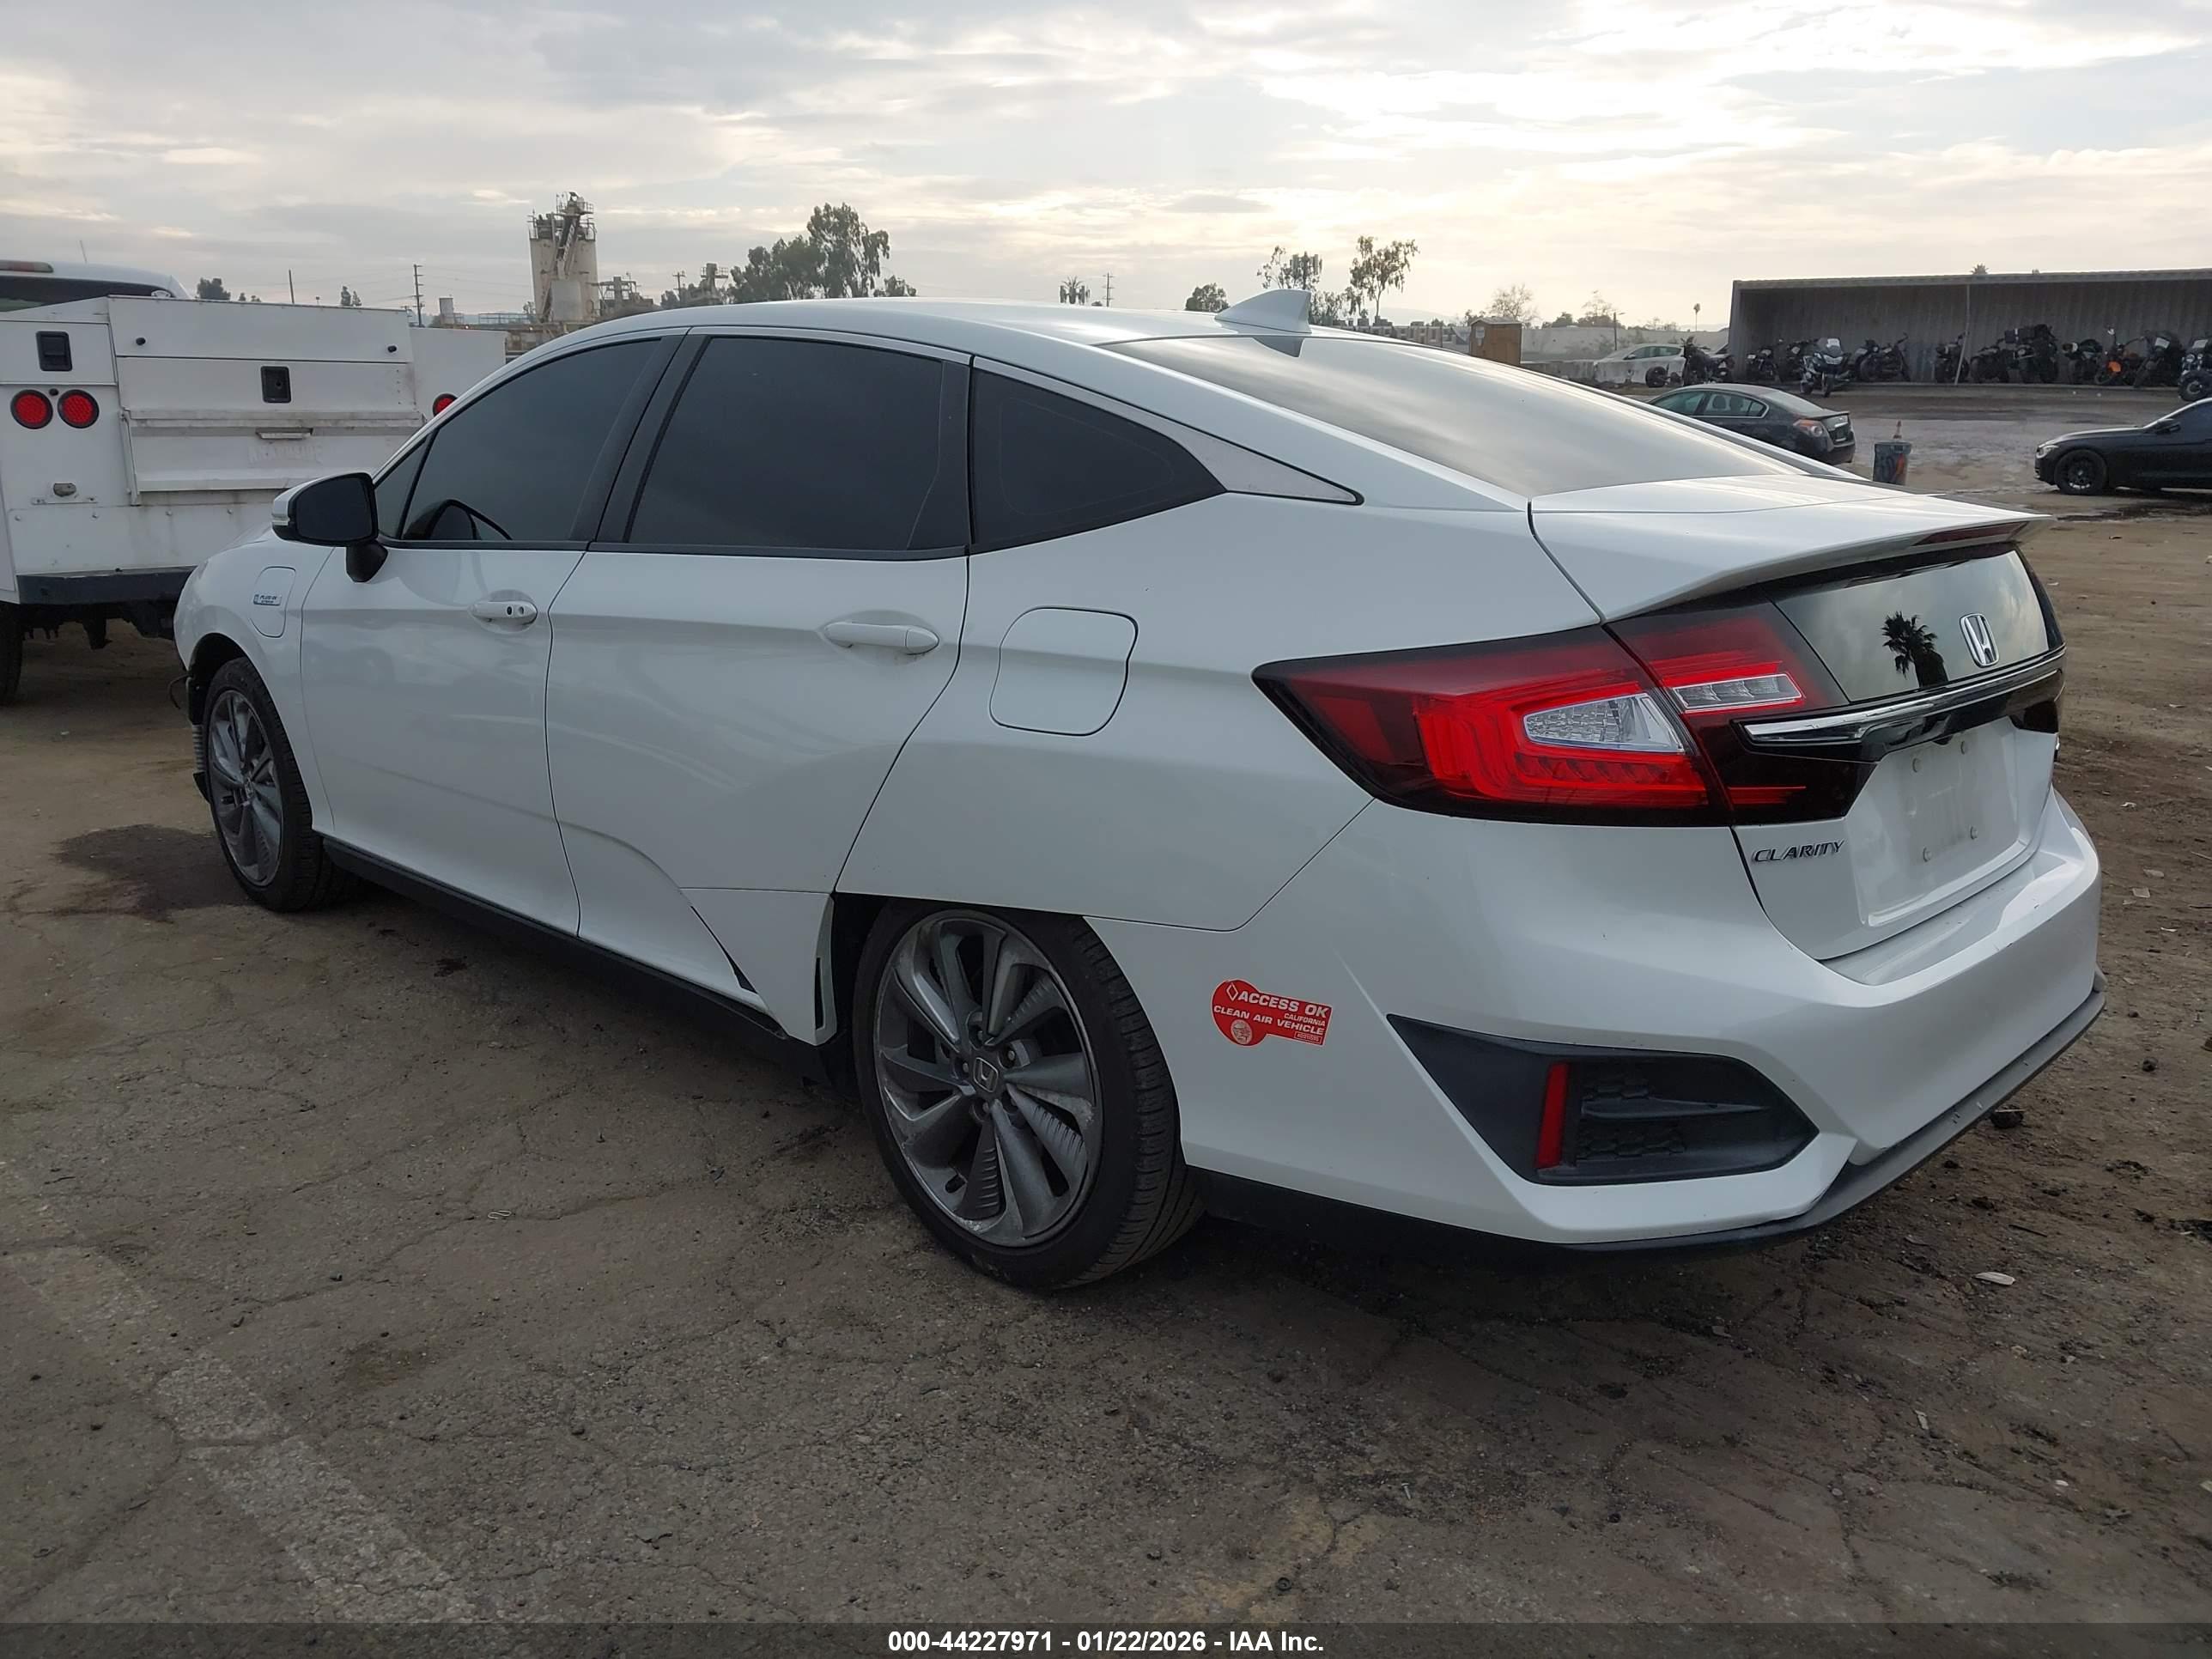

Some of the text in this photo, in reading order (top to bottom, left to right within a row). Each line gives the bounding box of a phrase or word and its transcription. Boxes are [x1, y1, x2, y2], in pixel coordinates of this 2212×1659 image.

[1753, 840, 1845, 862] CLARITY
[1237, 990, 1329, 1018] ACCESS OK
[1213, 1005, 1325, 1036] CLEAN AIR VEHICLE
[1284, 1012, 1326, 1027] CALIFORNIA
